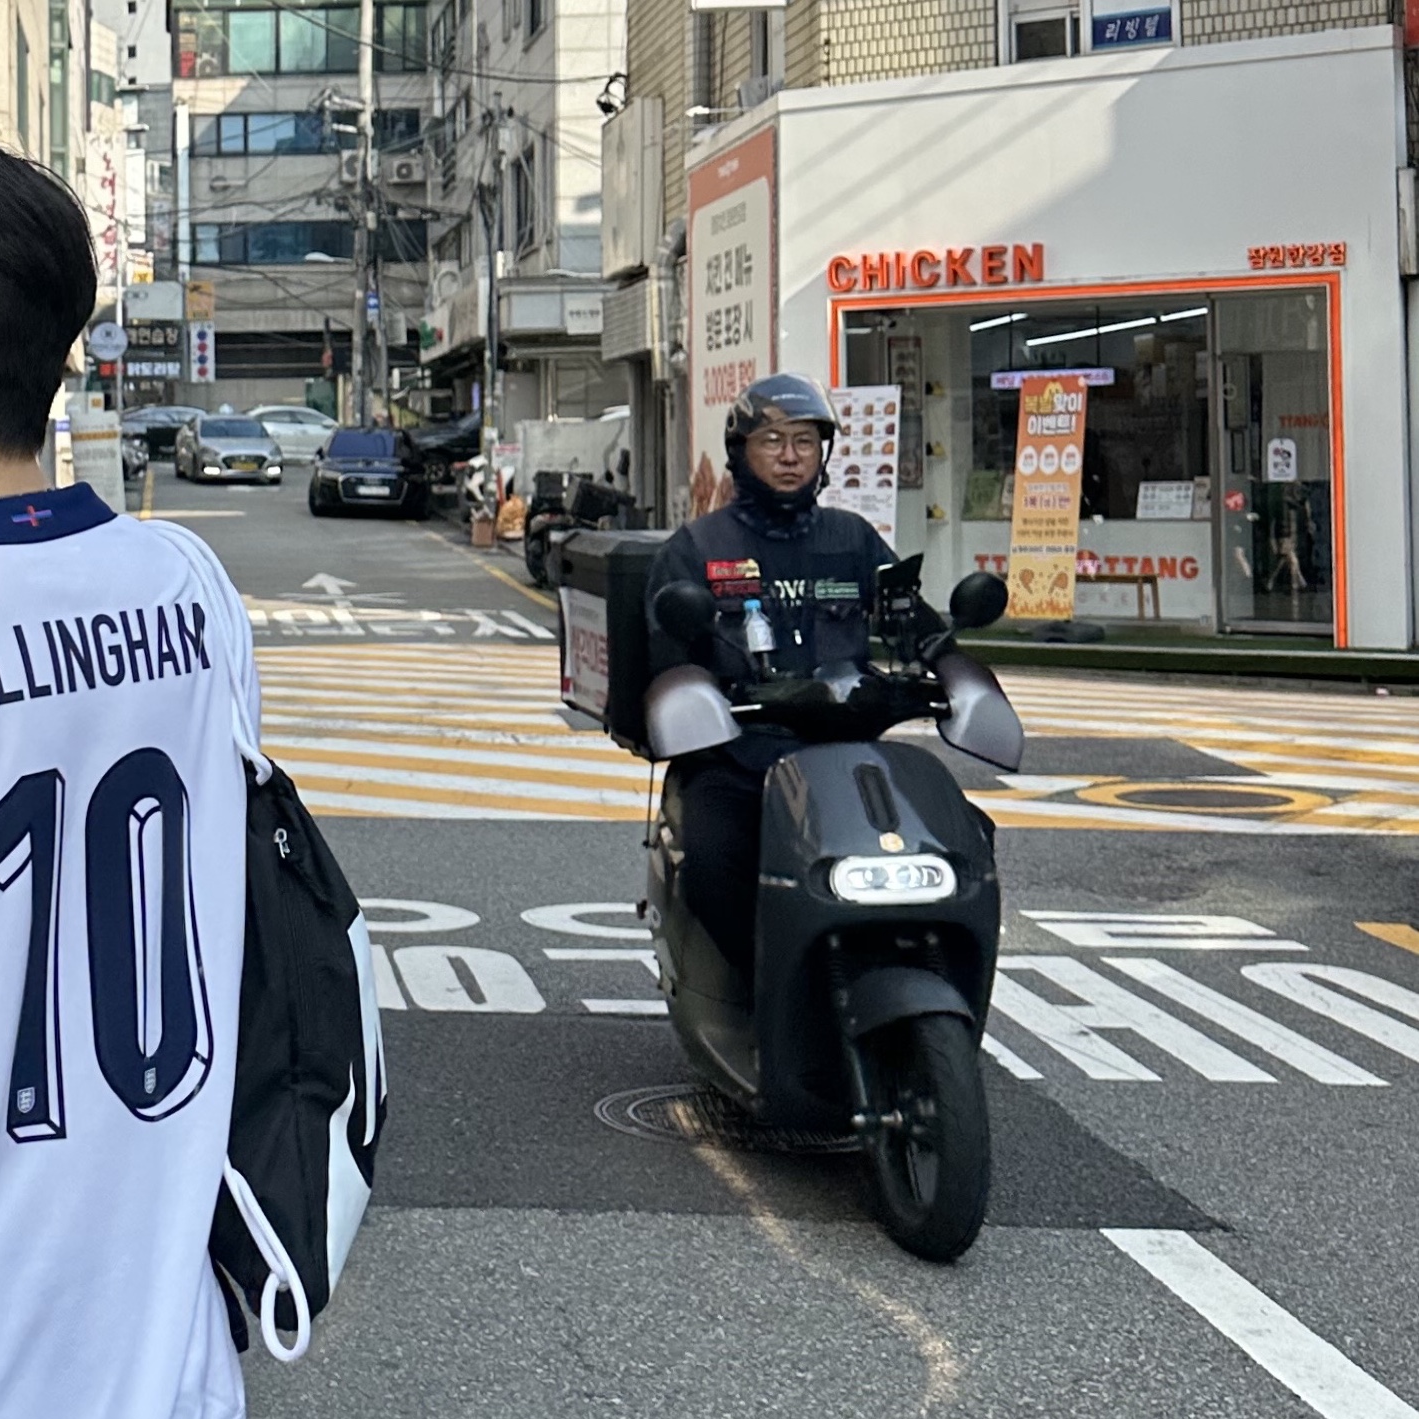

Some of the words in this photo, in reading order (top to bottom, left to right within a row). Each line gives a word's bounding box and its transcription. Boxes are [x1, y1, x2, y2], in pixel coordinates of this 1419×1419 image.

[1104, 14, 1160, 39] 리빙텔
[826, 243, 1046, 293] CHICKEN
[1247, 241, 1347, 270] 잠원한강점
[706, 308, 722, 352] 방문
[724, 303, 741, 347] 포장
[743, 299, 753, 342] 시
[1104, 555, 1199, 580] TTANG
